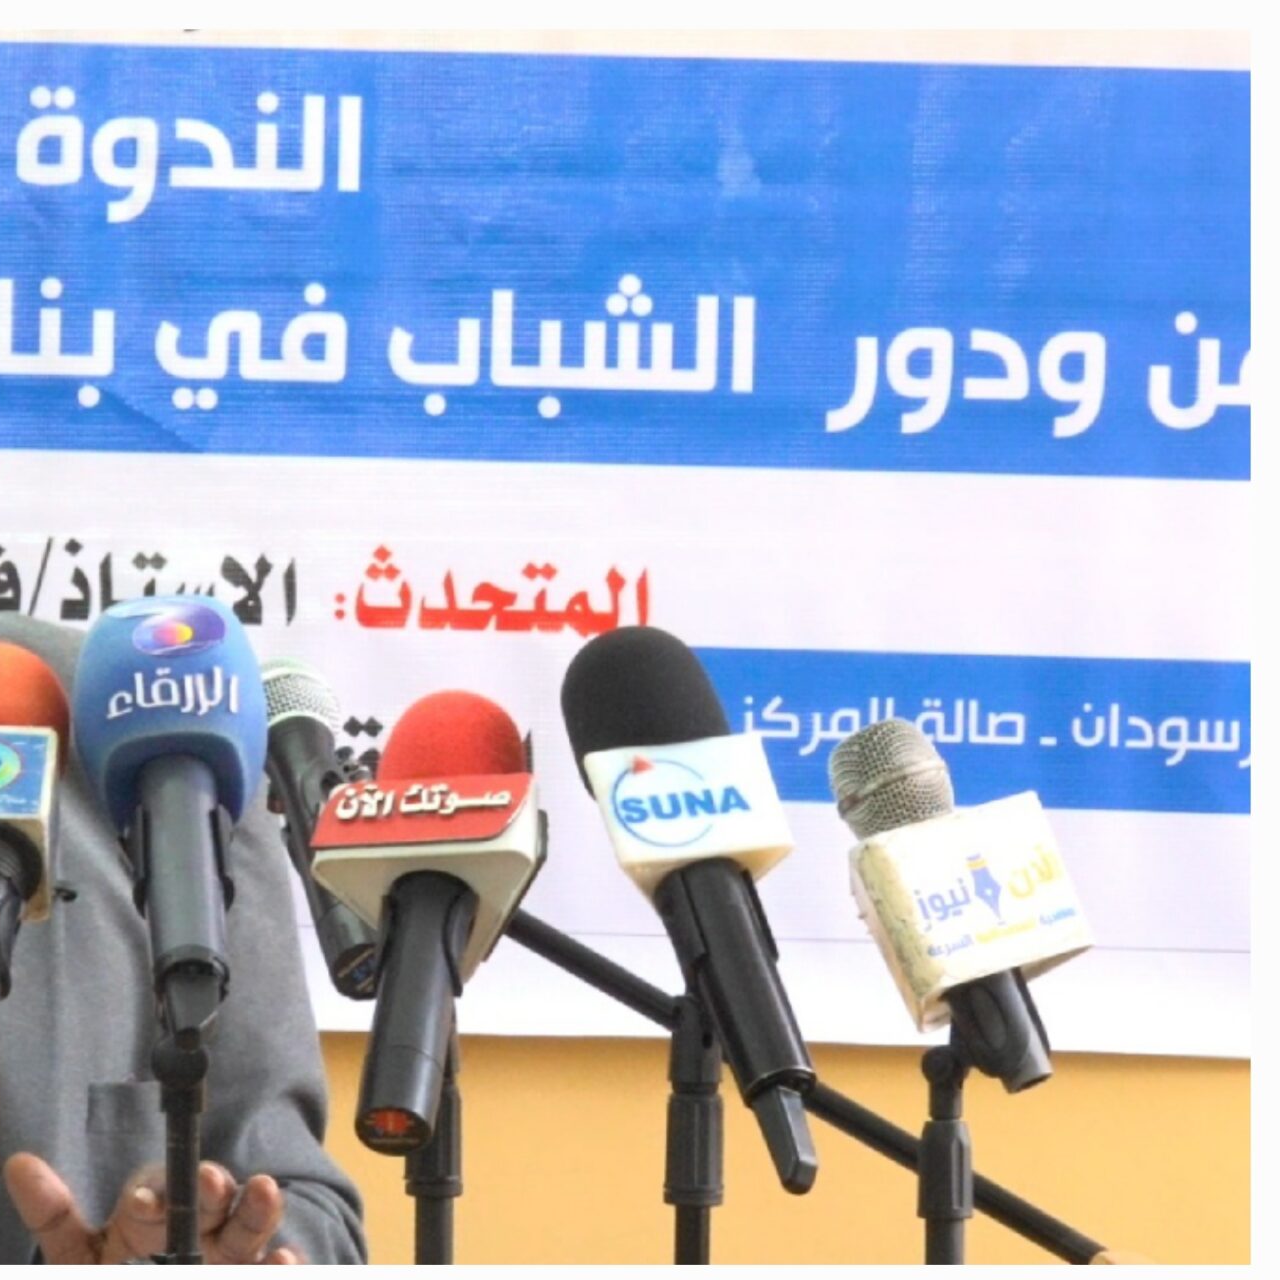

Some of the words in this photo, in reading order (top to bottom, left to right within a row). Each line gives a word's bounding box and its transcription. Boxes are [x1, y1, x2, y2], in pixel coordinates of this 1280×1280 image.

[16, 85, 362, 223] الندوة
[155, 283, 348, 410] في
[388, 274, 756, 418] الشباب
[826, 327, 1107, 438] ودور
[335, 545, 649, 637] المتحدث:
[915, 698, 1026, 746] صالة
[621, 785, 751, 824] SUNA
[914, 877, 972, 933] نيوز
